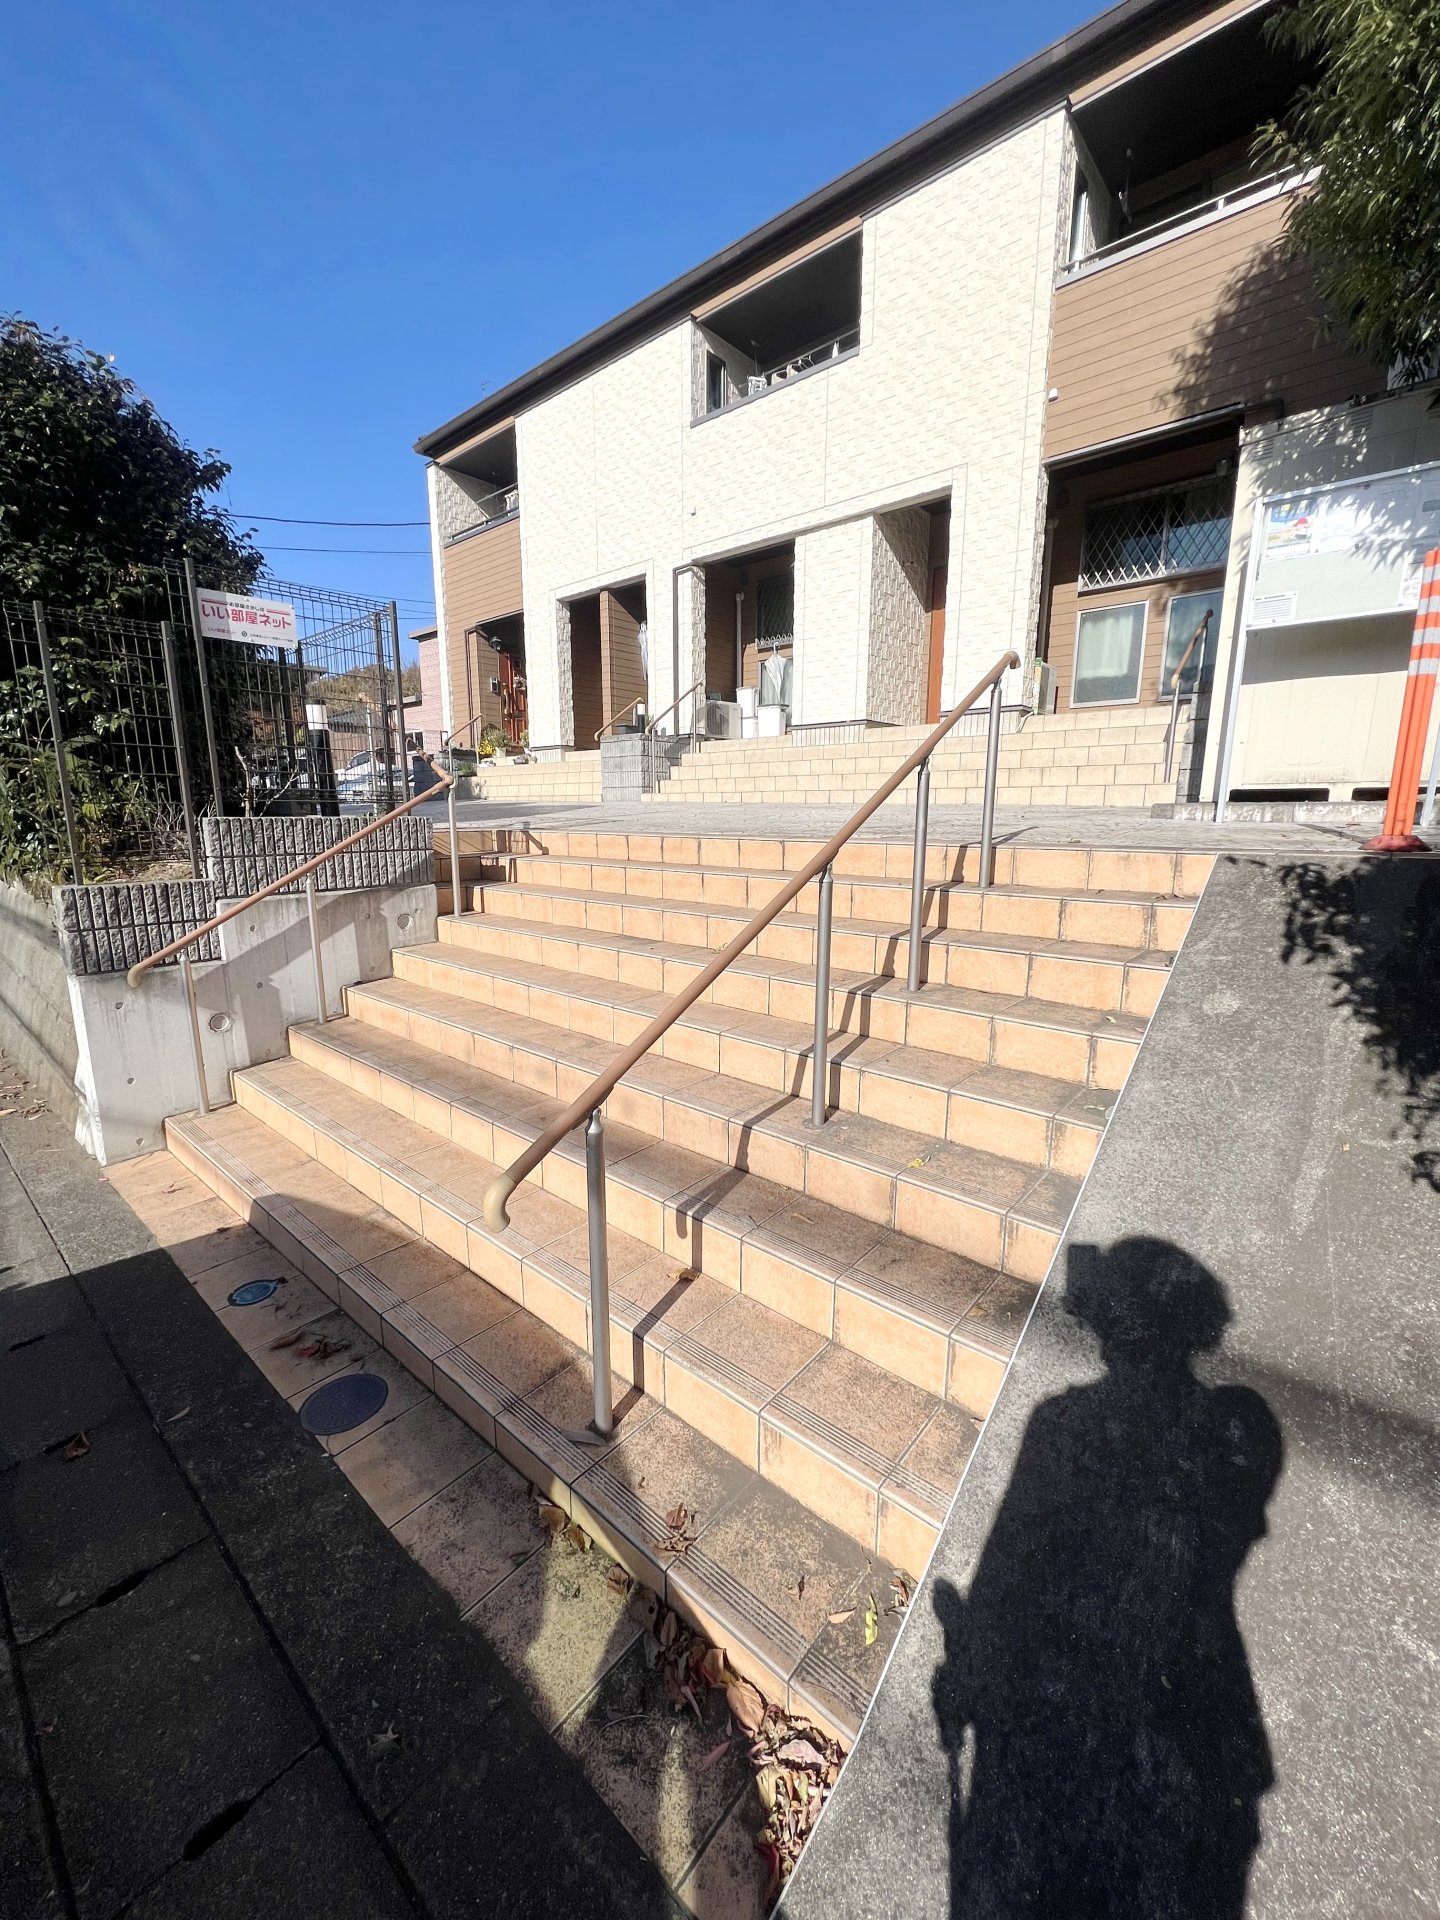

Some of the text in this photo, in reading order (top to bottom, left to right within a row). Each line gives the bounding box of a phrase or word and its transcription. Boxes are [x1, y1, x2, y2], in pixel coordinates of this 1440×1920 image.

[202, 604, 292, 629] いい部屋ネット
